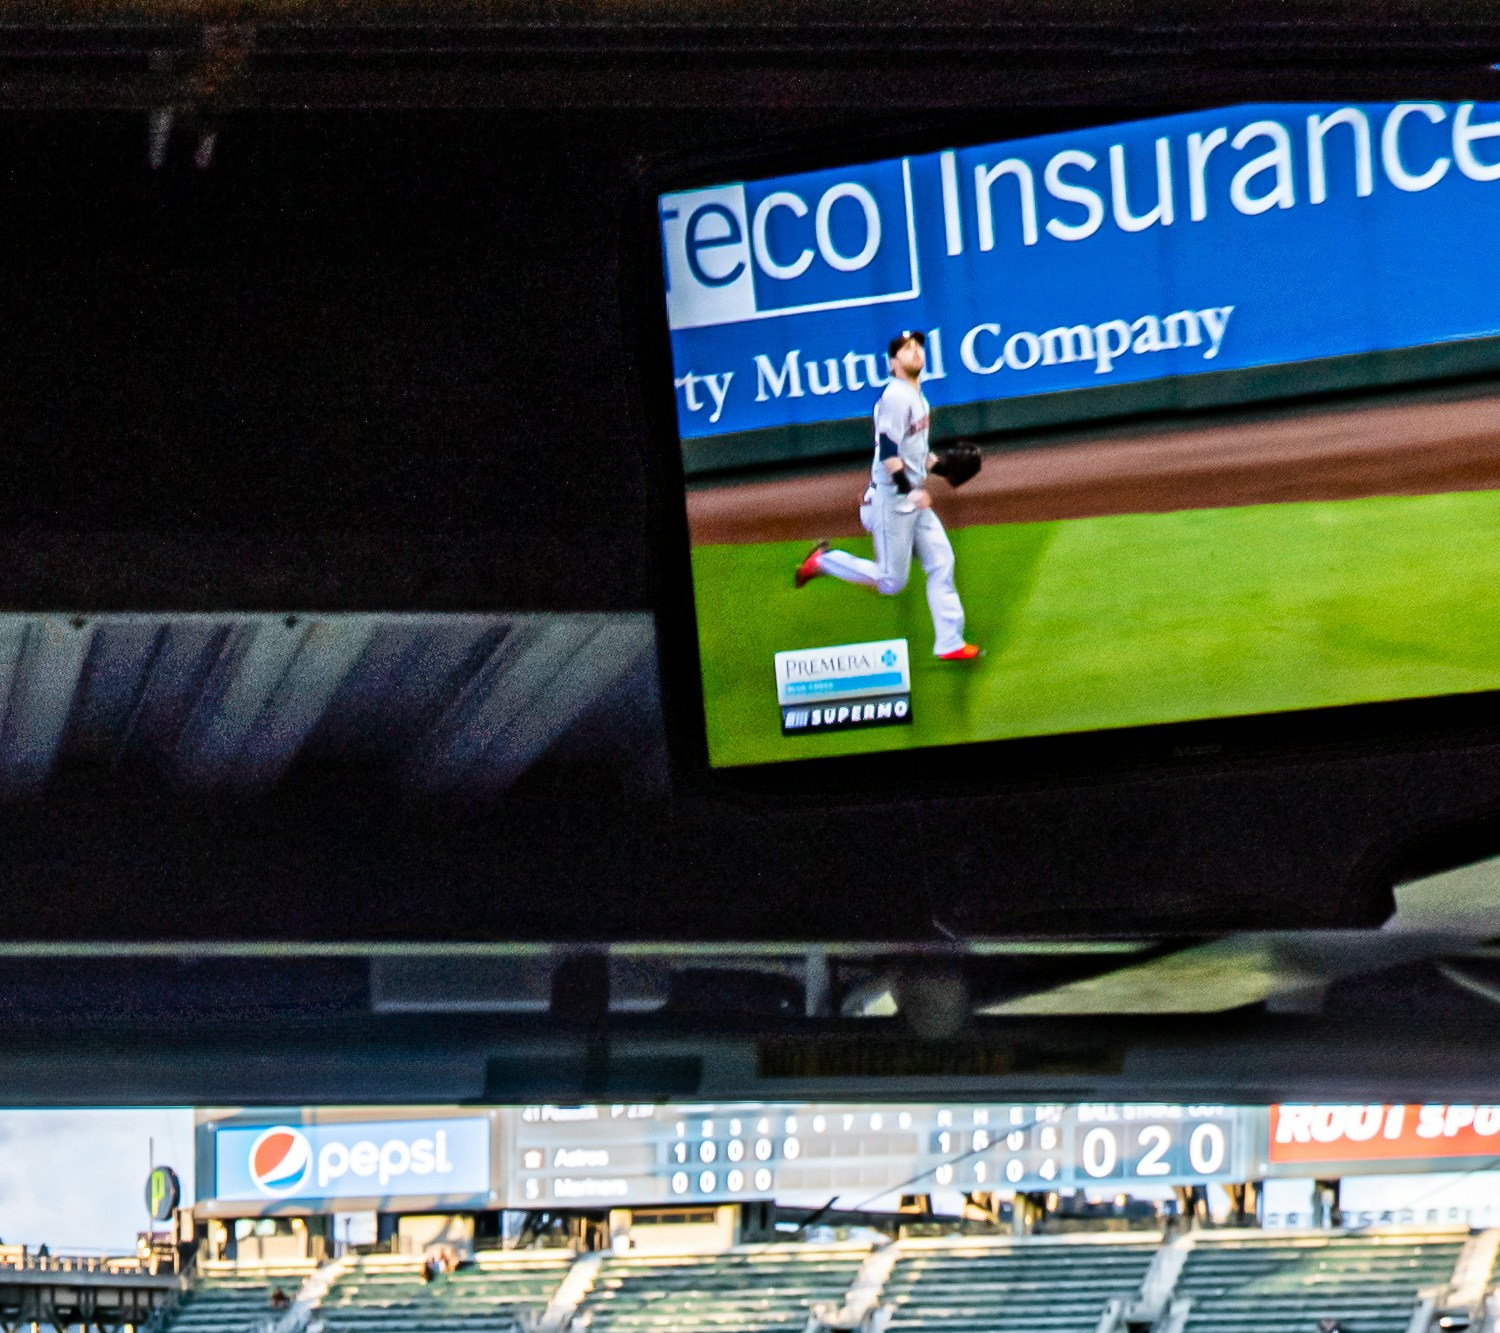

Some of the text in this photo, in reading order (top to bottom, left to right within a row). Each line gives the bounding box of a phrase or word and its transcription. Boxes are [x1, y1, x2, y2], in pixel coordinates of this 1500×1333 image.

[661, 183, 882, 288] eco
[674, 304, 1236, 423] ty Mutul Company
[785, 654, 871, 680] PREMERA
[318, 1129, 452, 1188] pepsi
[674, 1142, 687, 1163] 1
[700, 1141, 716, 1163] 0
[728, 1139, 744, 1162] 0
[755, 1138, 772, 1161] 0
[783, 1137, 800, 1160] 0
[1082, 1122, 1224, 1178] 0 2 0
[672, 1171, 689, 1194] 0
[700, 1170, 716, 1193] 0
[728, 1169, 744, 1192] 0
[755, 1168, 772, 1191] 0
